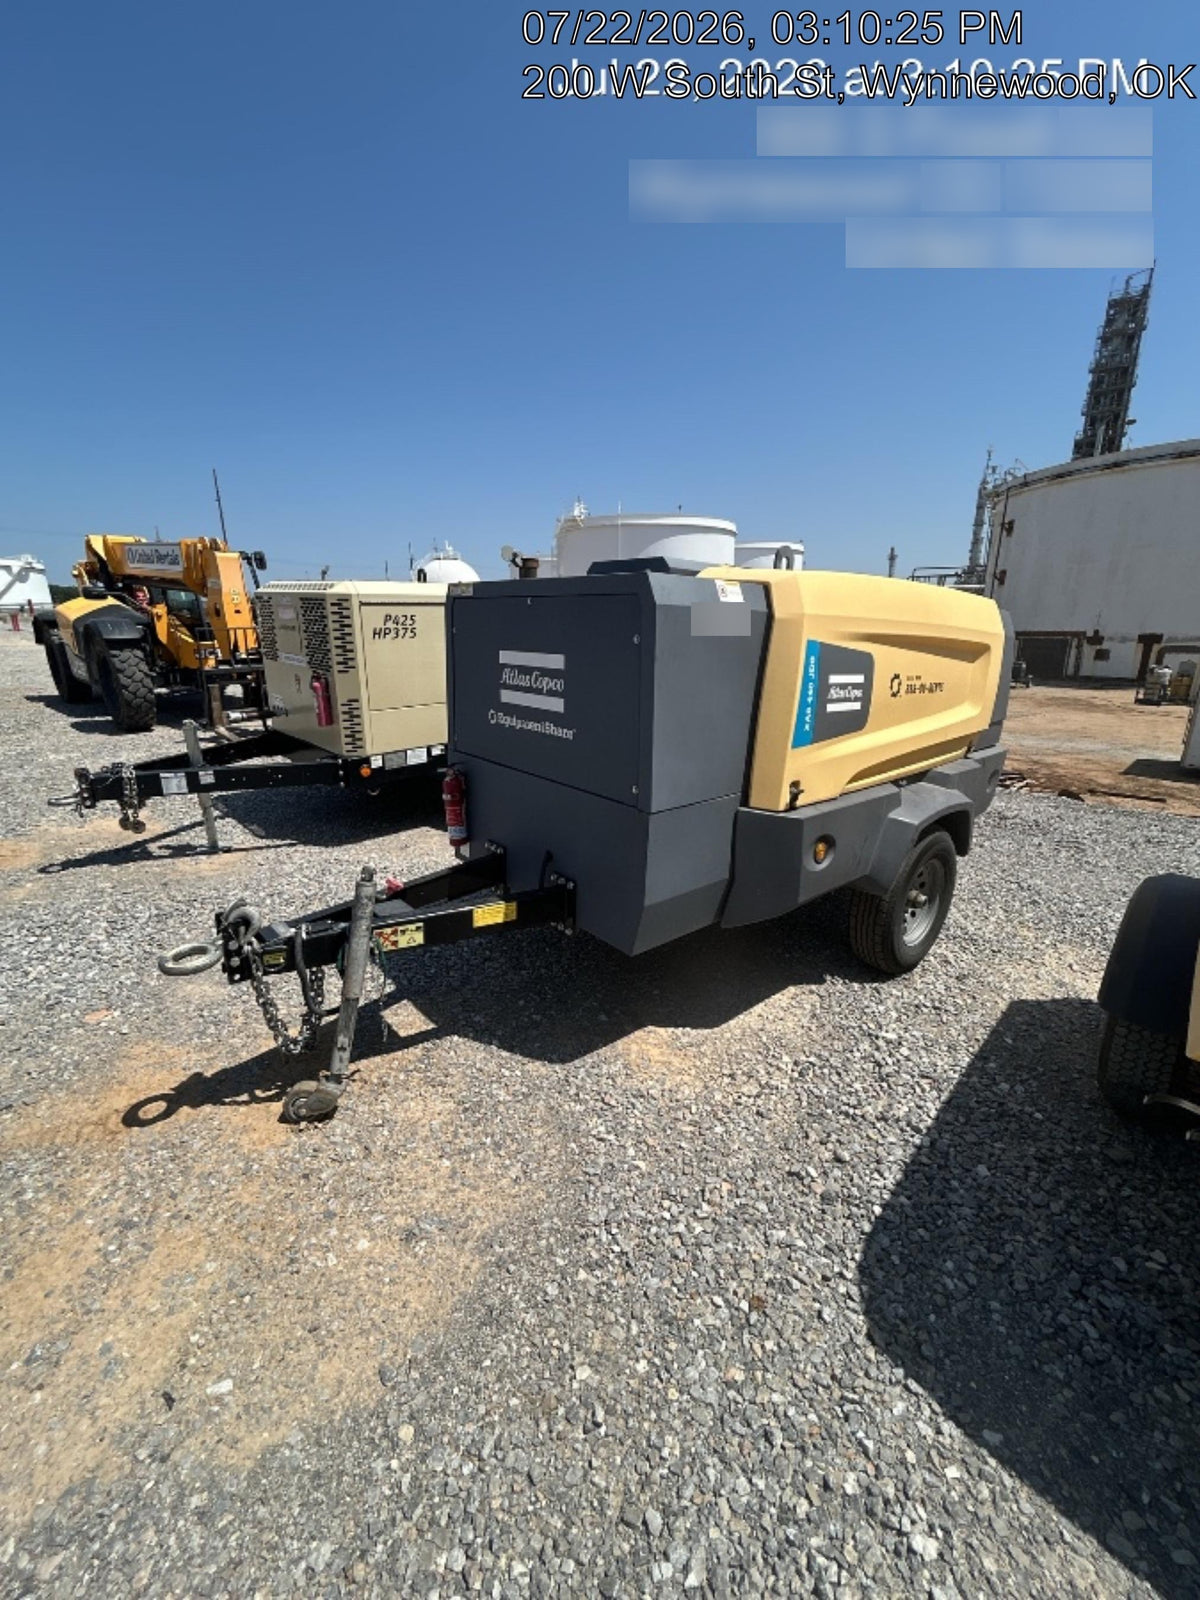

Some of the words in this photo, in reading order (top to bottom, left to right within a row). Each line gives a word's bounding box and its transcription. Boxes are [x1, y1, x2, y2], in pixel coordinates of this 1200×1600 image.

[383, 614, 417, 626] P425
[372, 627, 417, 640] HP375
[500, 667, 530, 688] Atlas
[530, 671, 564, 693] Copco
